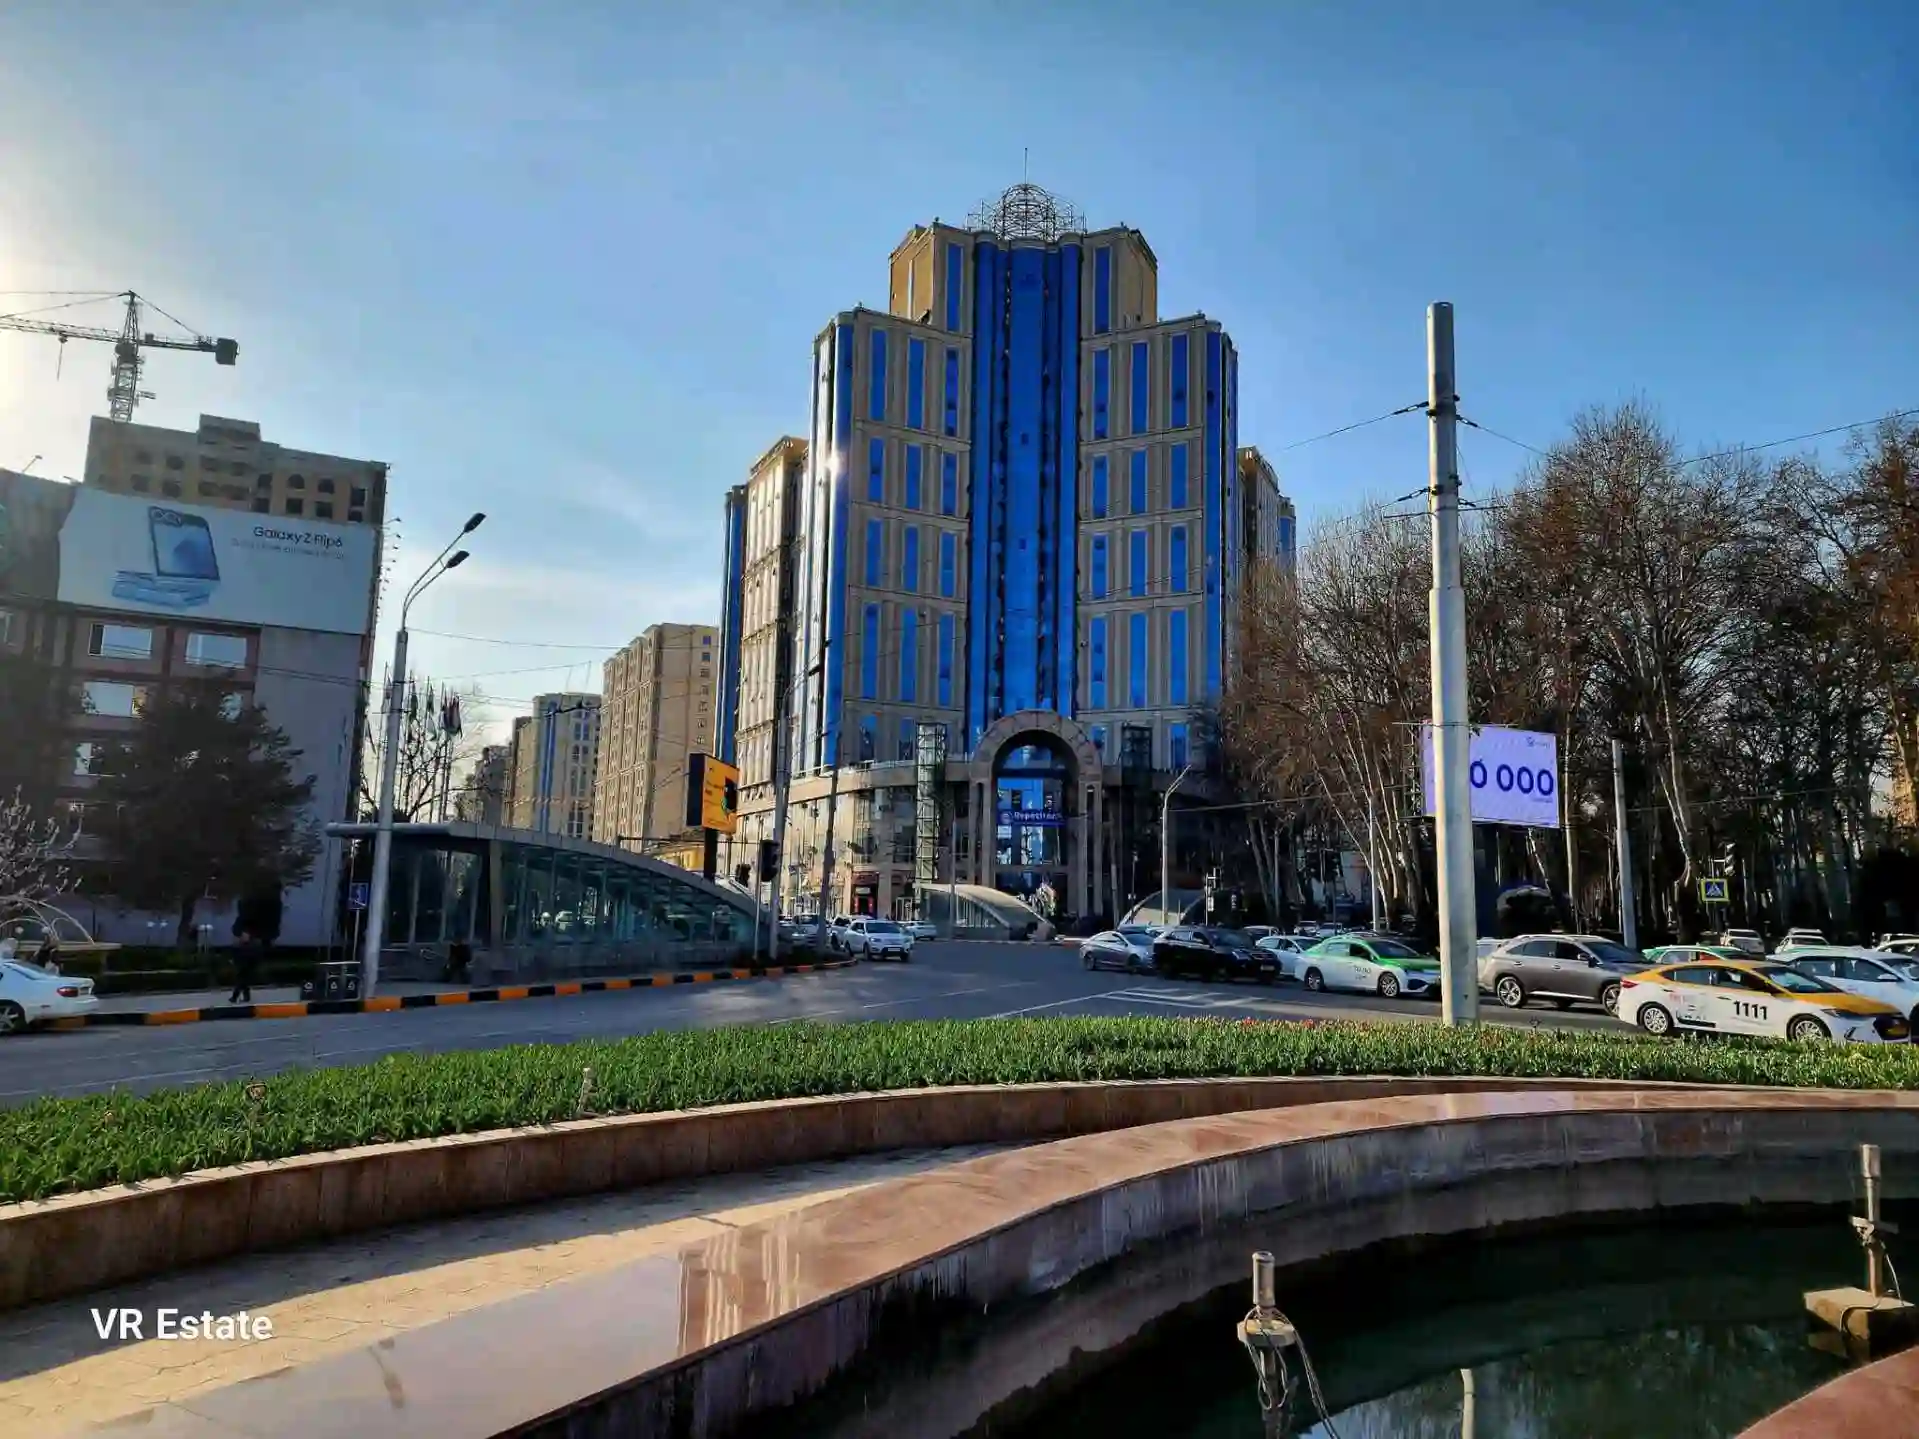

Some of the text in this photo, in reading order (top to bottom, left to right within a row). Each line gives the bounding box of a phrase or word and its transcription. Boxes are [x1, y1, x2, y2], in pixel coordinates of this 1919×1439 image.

[253, 526, 303, 545] Galaxy
[303, 532, 312, 544] Z
[314, 533, 343, 549] Flip6
[1496, 763, 1554, 796] 000
[1734, 1000, 1768, 1020] 1111
